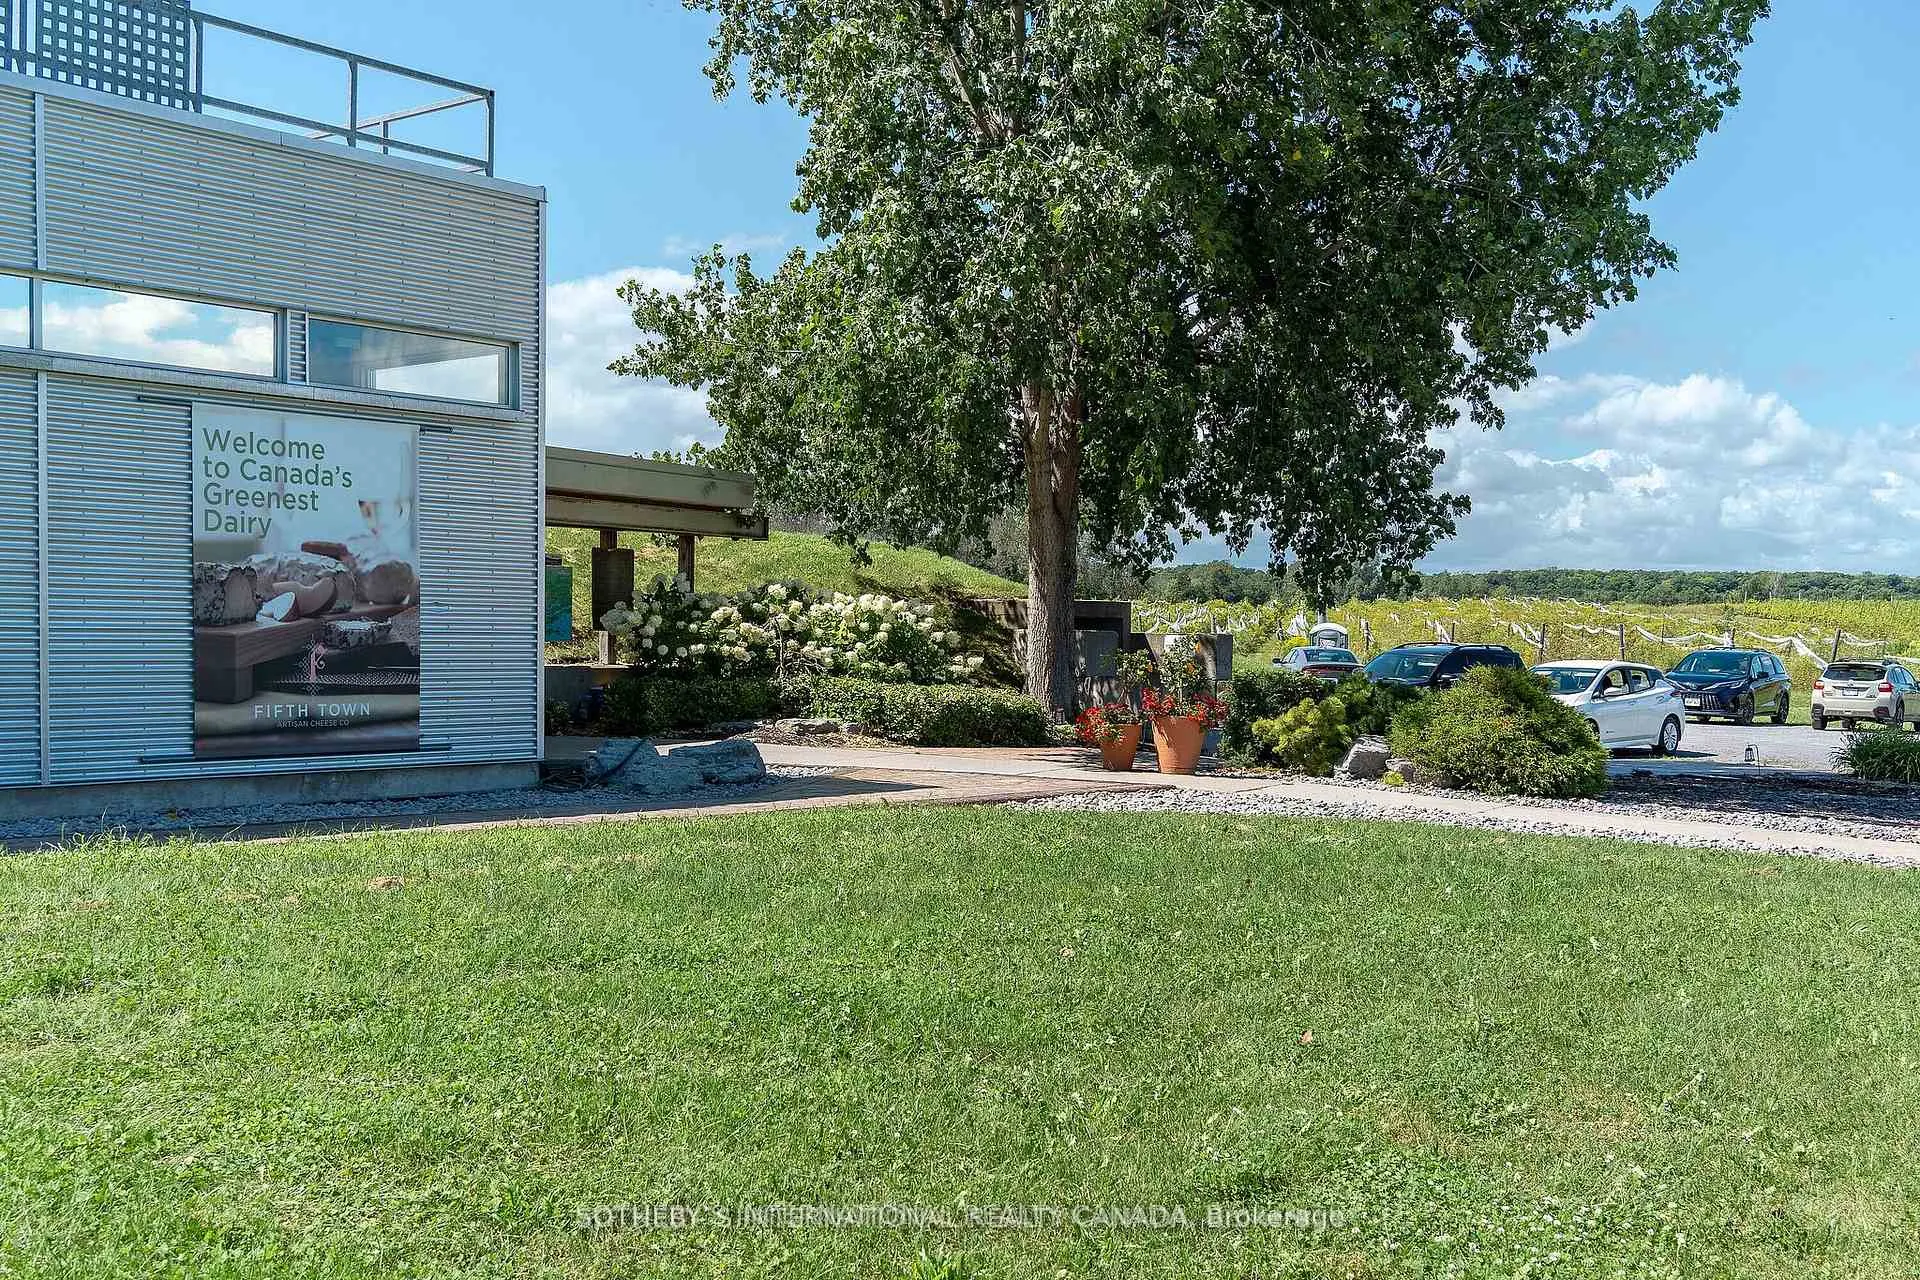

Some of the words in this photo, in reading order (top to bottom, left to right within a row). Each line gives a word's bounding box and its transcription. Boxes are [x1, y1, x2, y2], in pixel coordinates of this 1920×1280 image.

[203, 428, 325, 460] Welcome
[203, 455, 230, 479] to
[240, 458, 353, 488] Canada's
[203, 482, 319, 512] Greenest
[204, 508, 272, 538] Dairy
[254, 704, 309, 719] FIFTH
[317, 703, 370, 717] TOWN
[278, 719, 309, 729] ARTISAN
